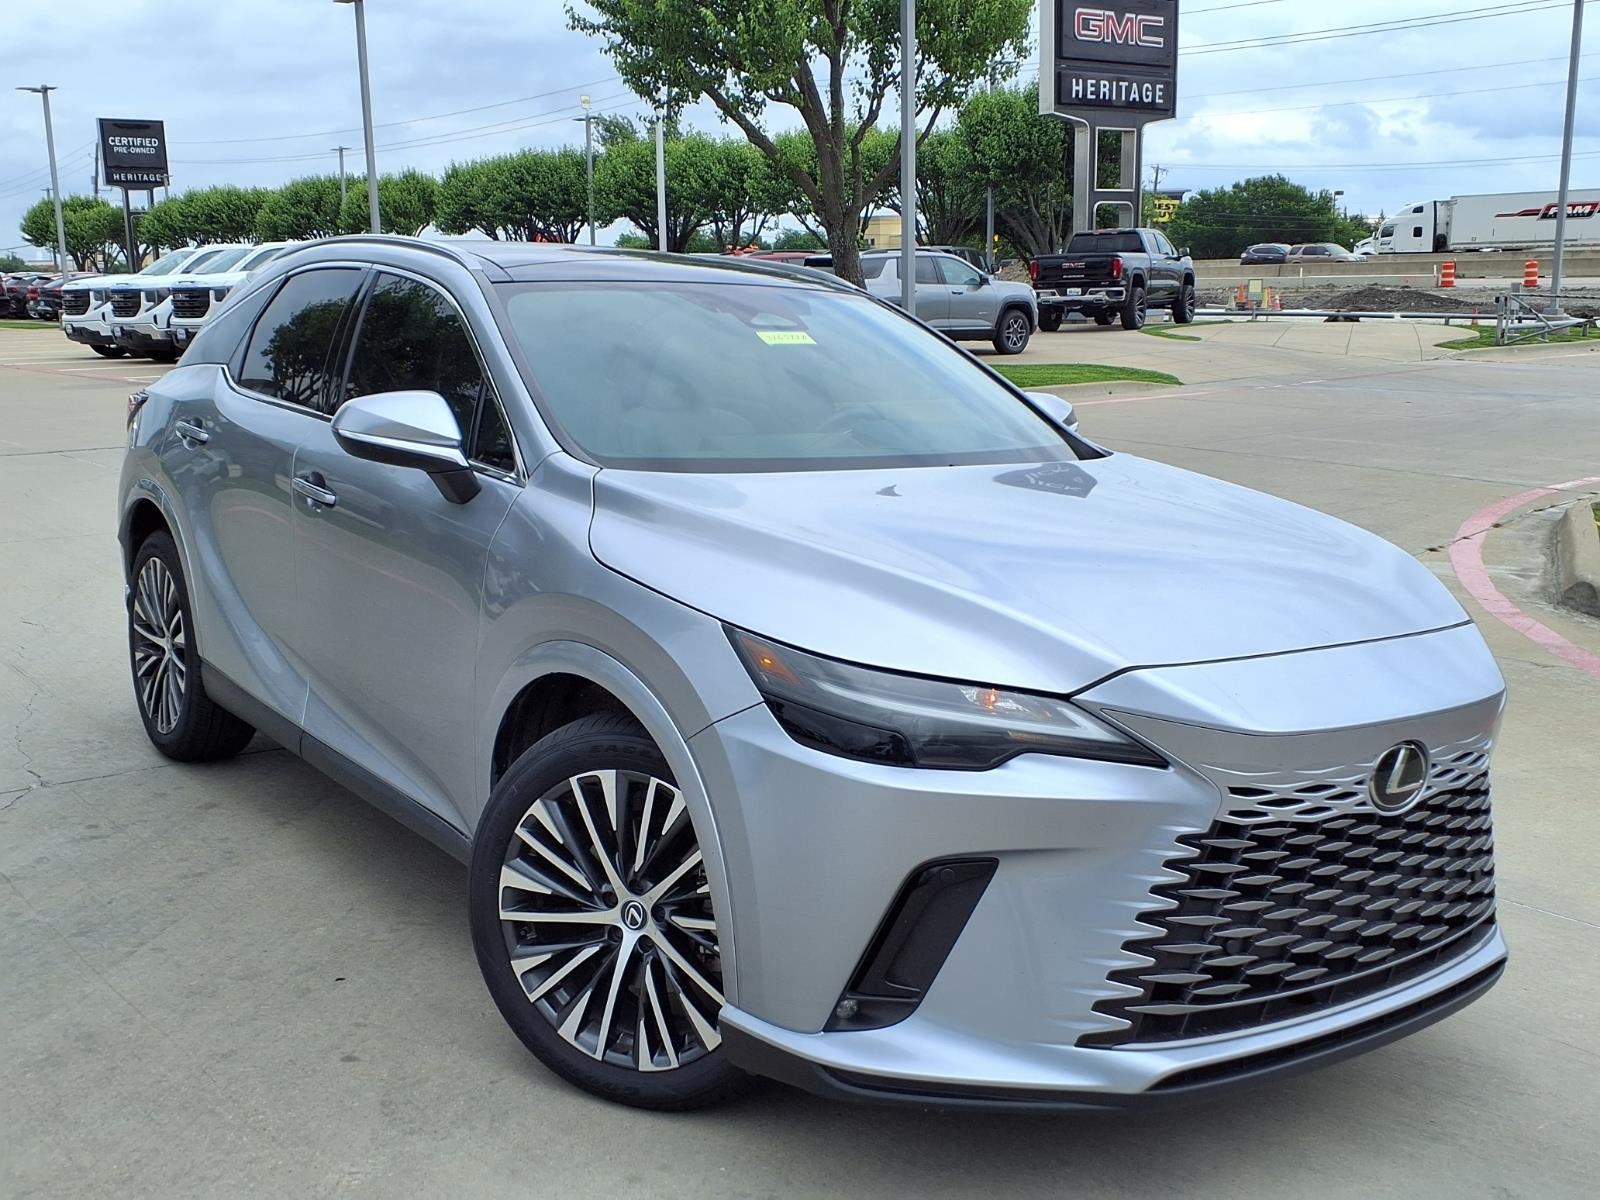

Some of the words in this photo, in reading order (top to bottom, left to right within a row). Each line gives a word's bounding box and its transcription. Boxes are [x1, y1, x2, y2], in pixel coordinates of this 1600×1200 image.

[1075, 8, 1164, 48] GMC
[1072, 78, 1164, 103] HERITAGE
[108, 136, 159, 146] CERTIFIED
[113, 173, 162, 181] HERITAGE
